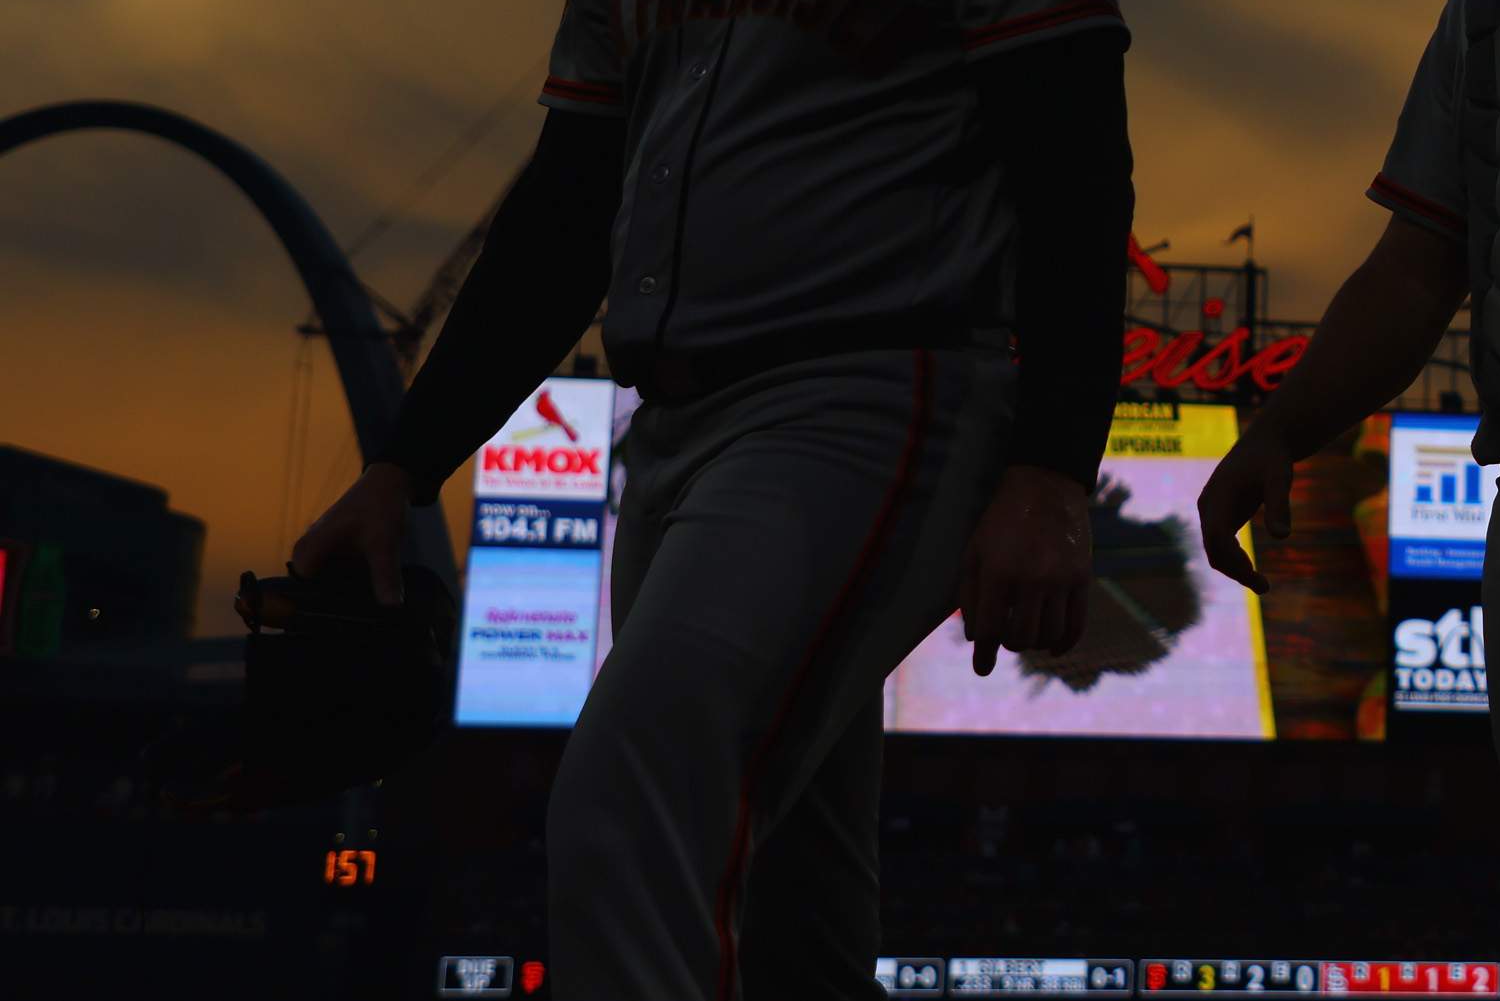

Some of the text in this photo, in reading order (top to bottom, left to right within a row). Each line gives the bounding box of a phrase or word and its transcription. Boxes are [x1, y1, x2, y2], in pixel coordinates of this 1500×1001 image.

[1121, 297, 1310, 393] eise
[484, 446, 601, 474] KMOX
[479, 515, 599, 543] 104.1 FM
[900, 965, 937, 989] 0-0
[1091, 966, 1126, 990] 0-1
[1198, 964, 1216, 992] 3
[1246, 964, 1265, 993] 2
[1295, 964, 1314, 993] 0
[1378, 966, 1391, 993] 1
[1425, 966, 1439, 993] 1
[1472, 965, 1491, 993] 2
